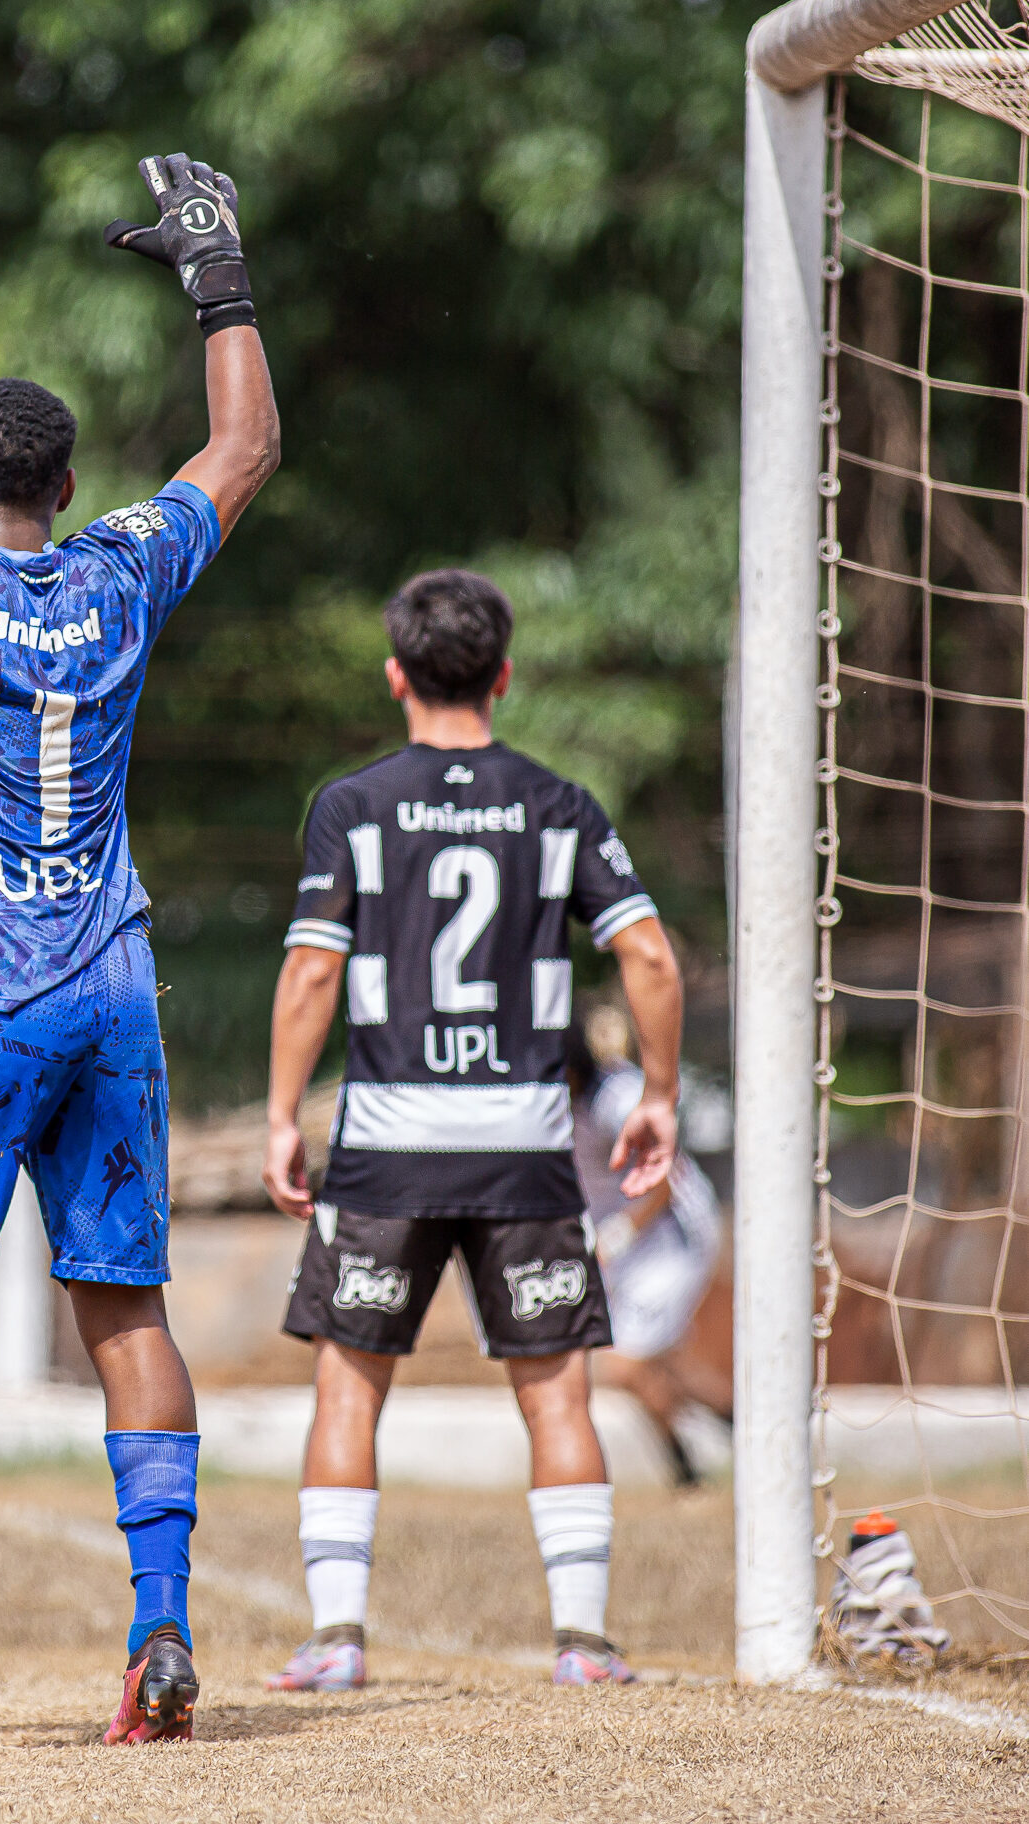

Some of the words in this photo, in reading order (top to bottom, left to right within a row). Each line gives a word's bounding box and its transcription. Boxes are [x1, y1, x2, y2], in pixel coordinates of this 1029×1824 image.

[31, 688, 77, 846] 1
[396, 801, 526, 834] Unimed
[428, 844, 501, 1014] 2
[423, 1023, 511, 1075] UPL
